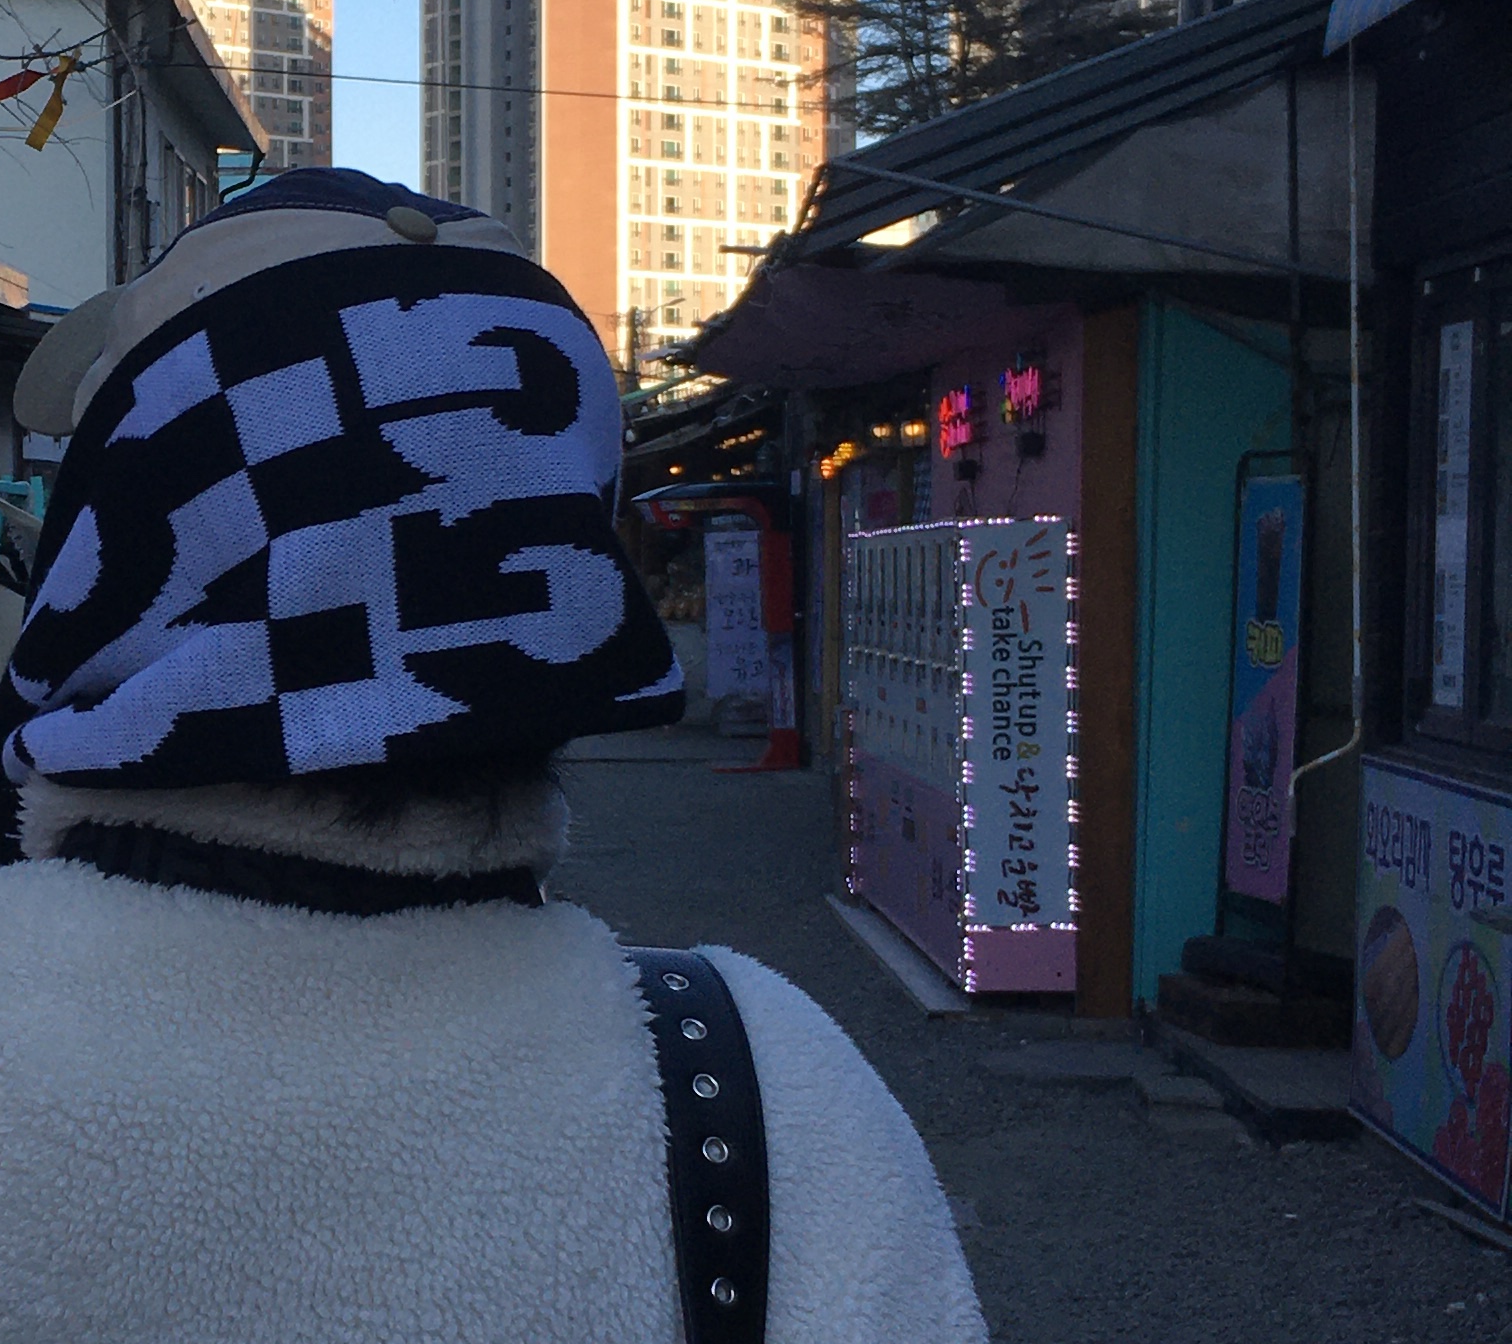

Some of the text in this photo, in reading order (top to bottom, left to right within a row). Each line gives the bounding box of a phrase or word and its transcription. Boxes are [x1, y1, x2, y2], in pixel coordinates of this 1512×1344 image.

[992, 606, 1018, 761] take chance
[1448, 830, 1505, 910] 탕후루
